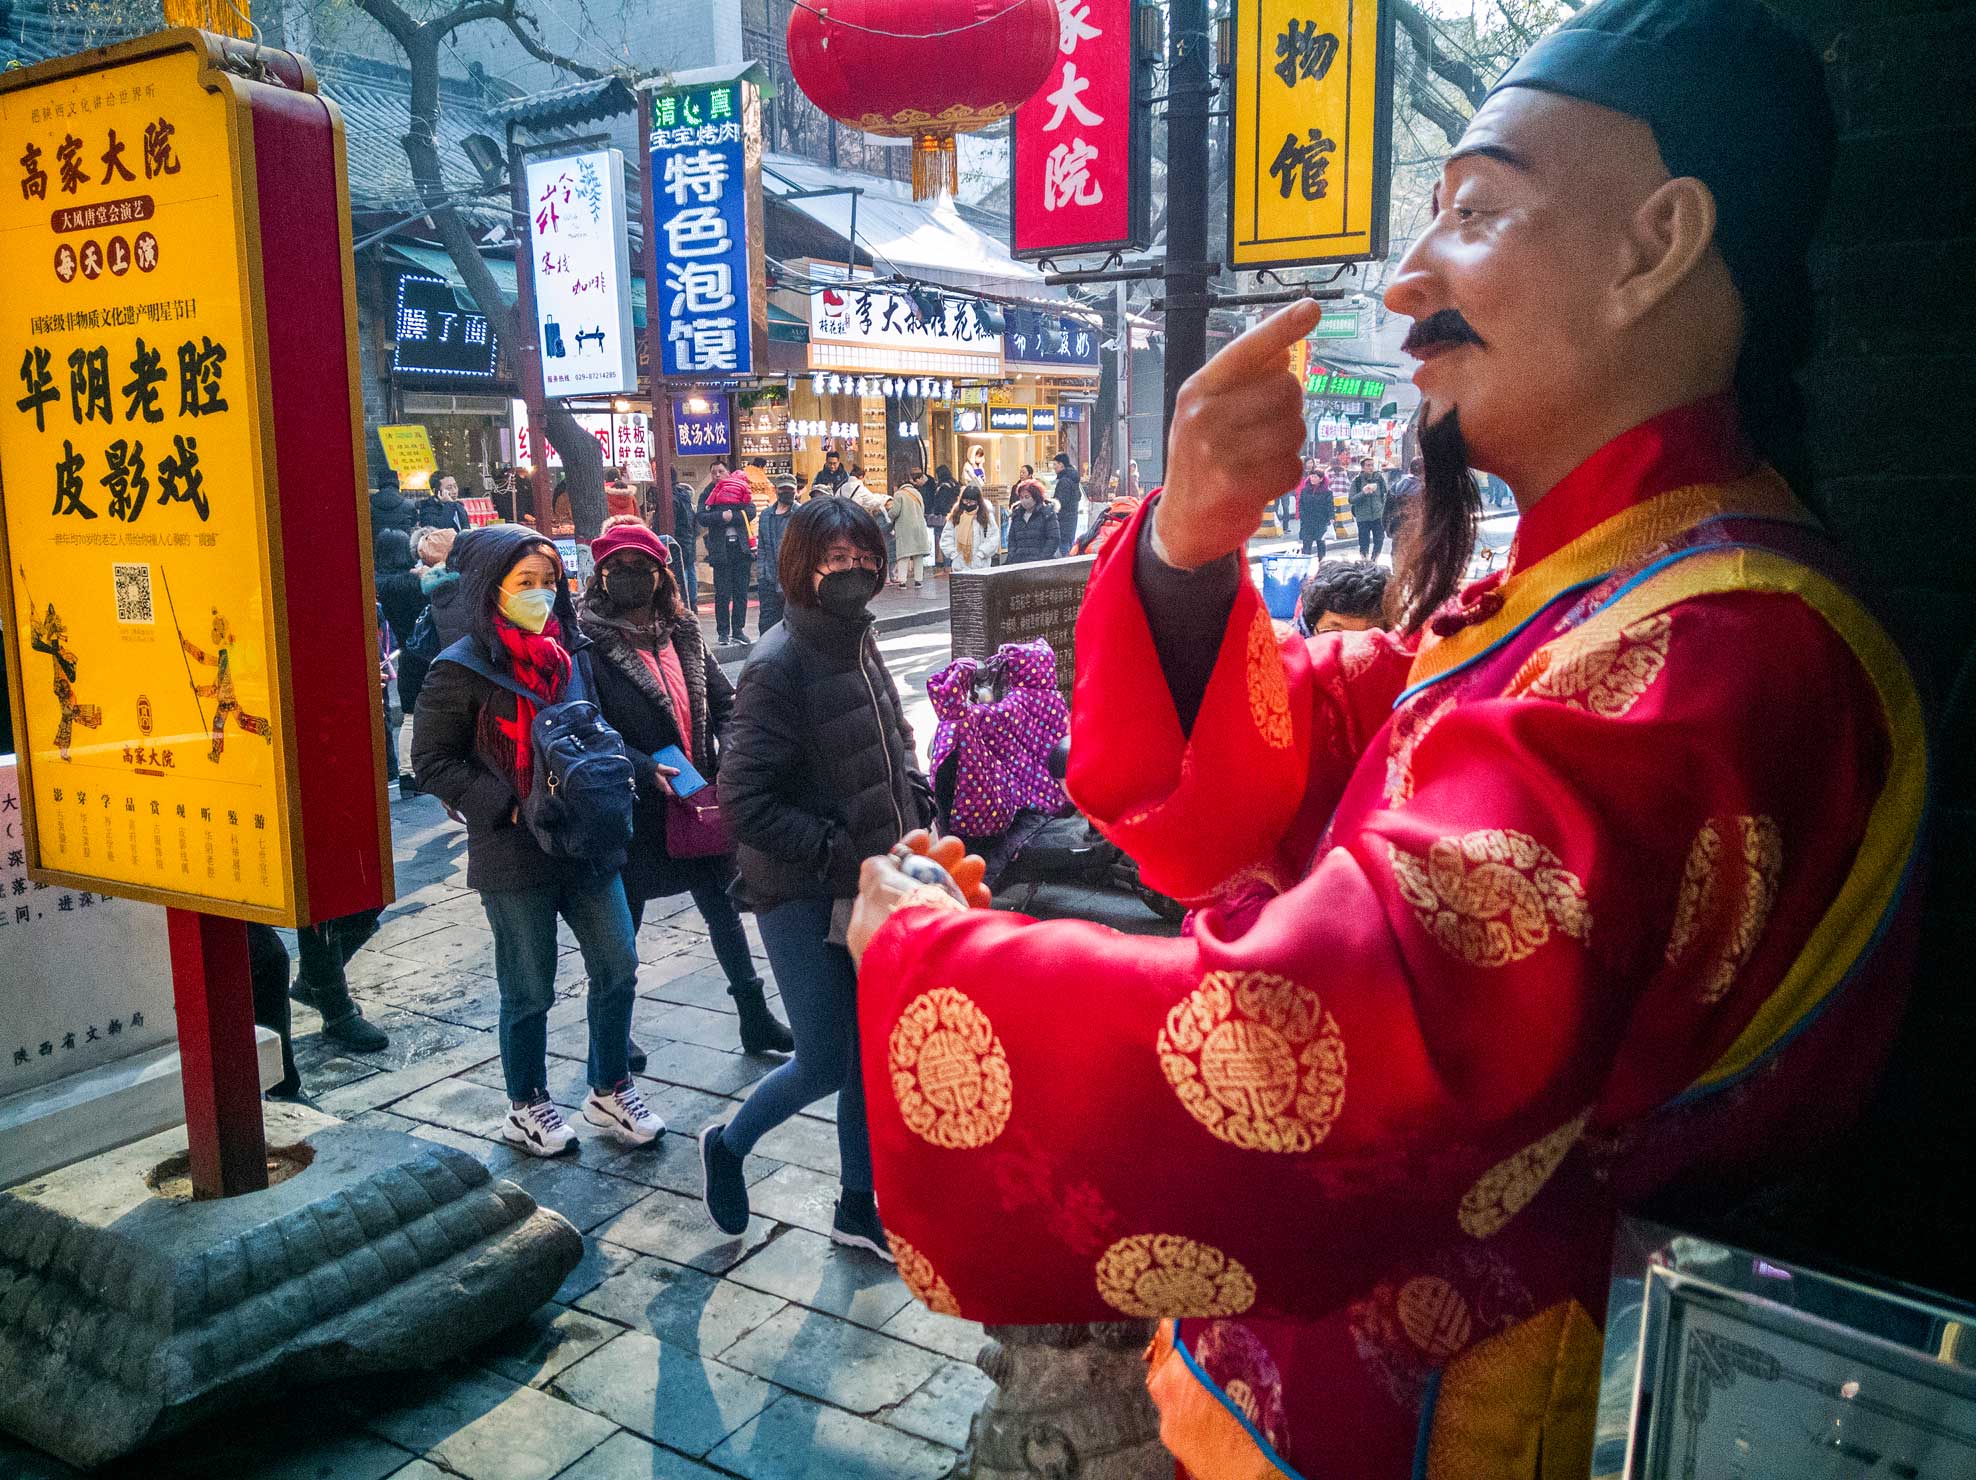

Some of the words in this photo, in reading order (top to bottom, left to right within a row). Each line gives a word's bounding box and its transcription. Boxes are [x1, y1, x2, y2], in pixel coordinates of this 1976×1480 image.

[1269, 18, 1339, 200] 物馆
[19, 117, 182, 201] 高家大院
[61, 200, 145, 230] 大风唐堂会演艺
[56, 236, 157, 281] 每天上演
[663, 149, 737, 371] 特色泡馍
[30, 298, 197, 336] 国家级非物质文化遗产明星节目
[16, 335, 229, 432] 华阴老腔
[618, 425, 645, 443] 铁板
[678, 421, 727, 446] 酸汤水饺
[52, 434, 209, 523] 皮影戏
[122, 744, 175, 769] 高家大院
[13, 1011, 145, 1067] 陕西省文物局
